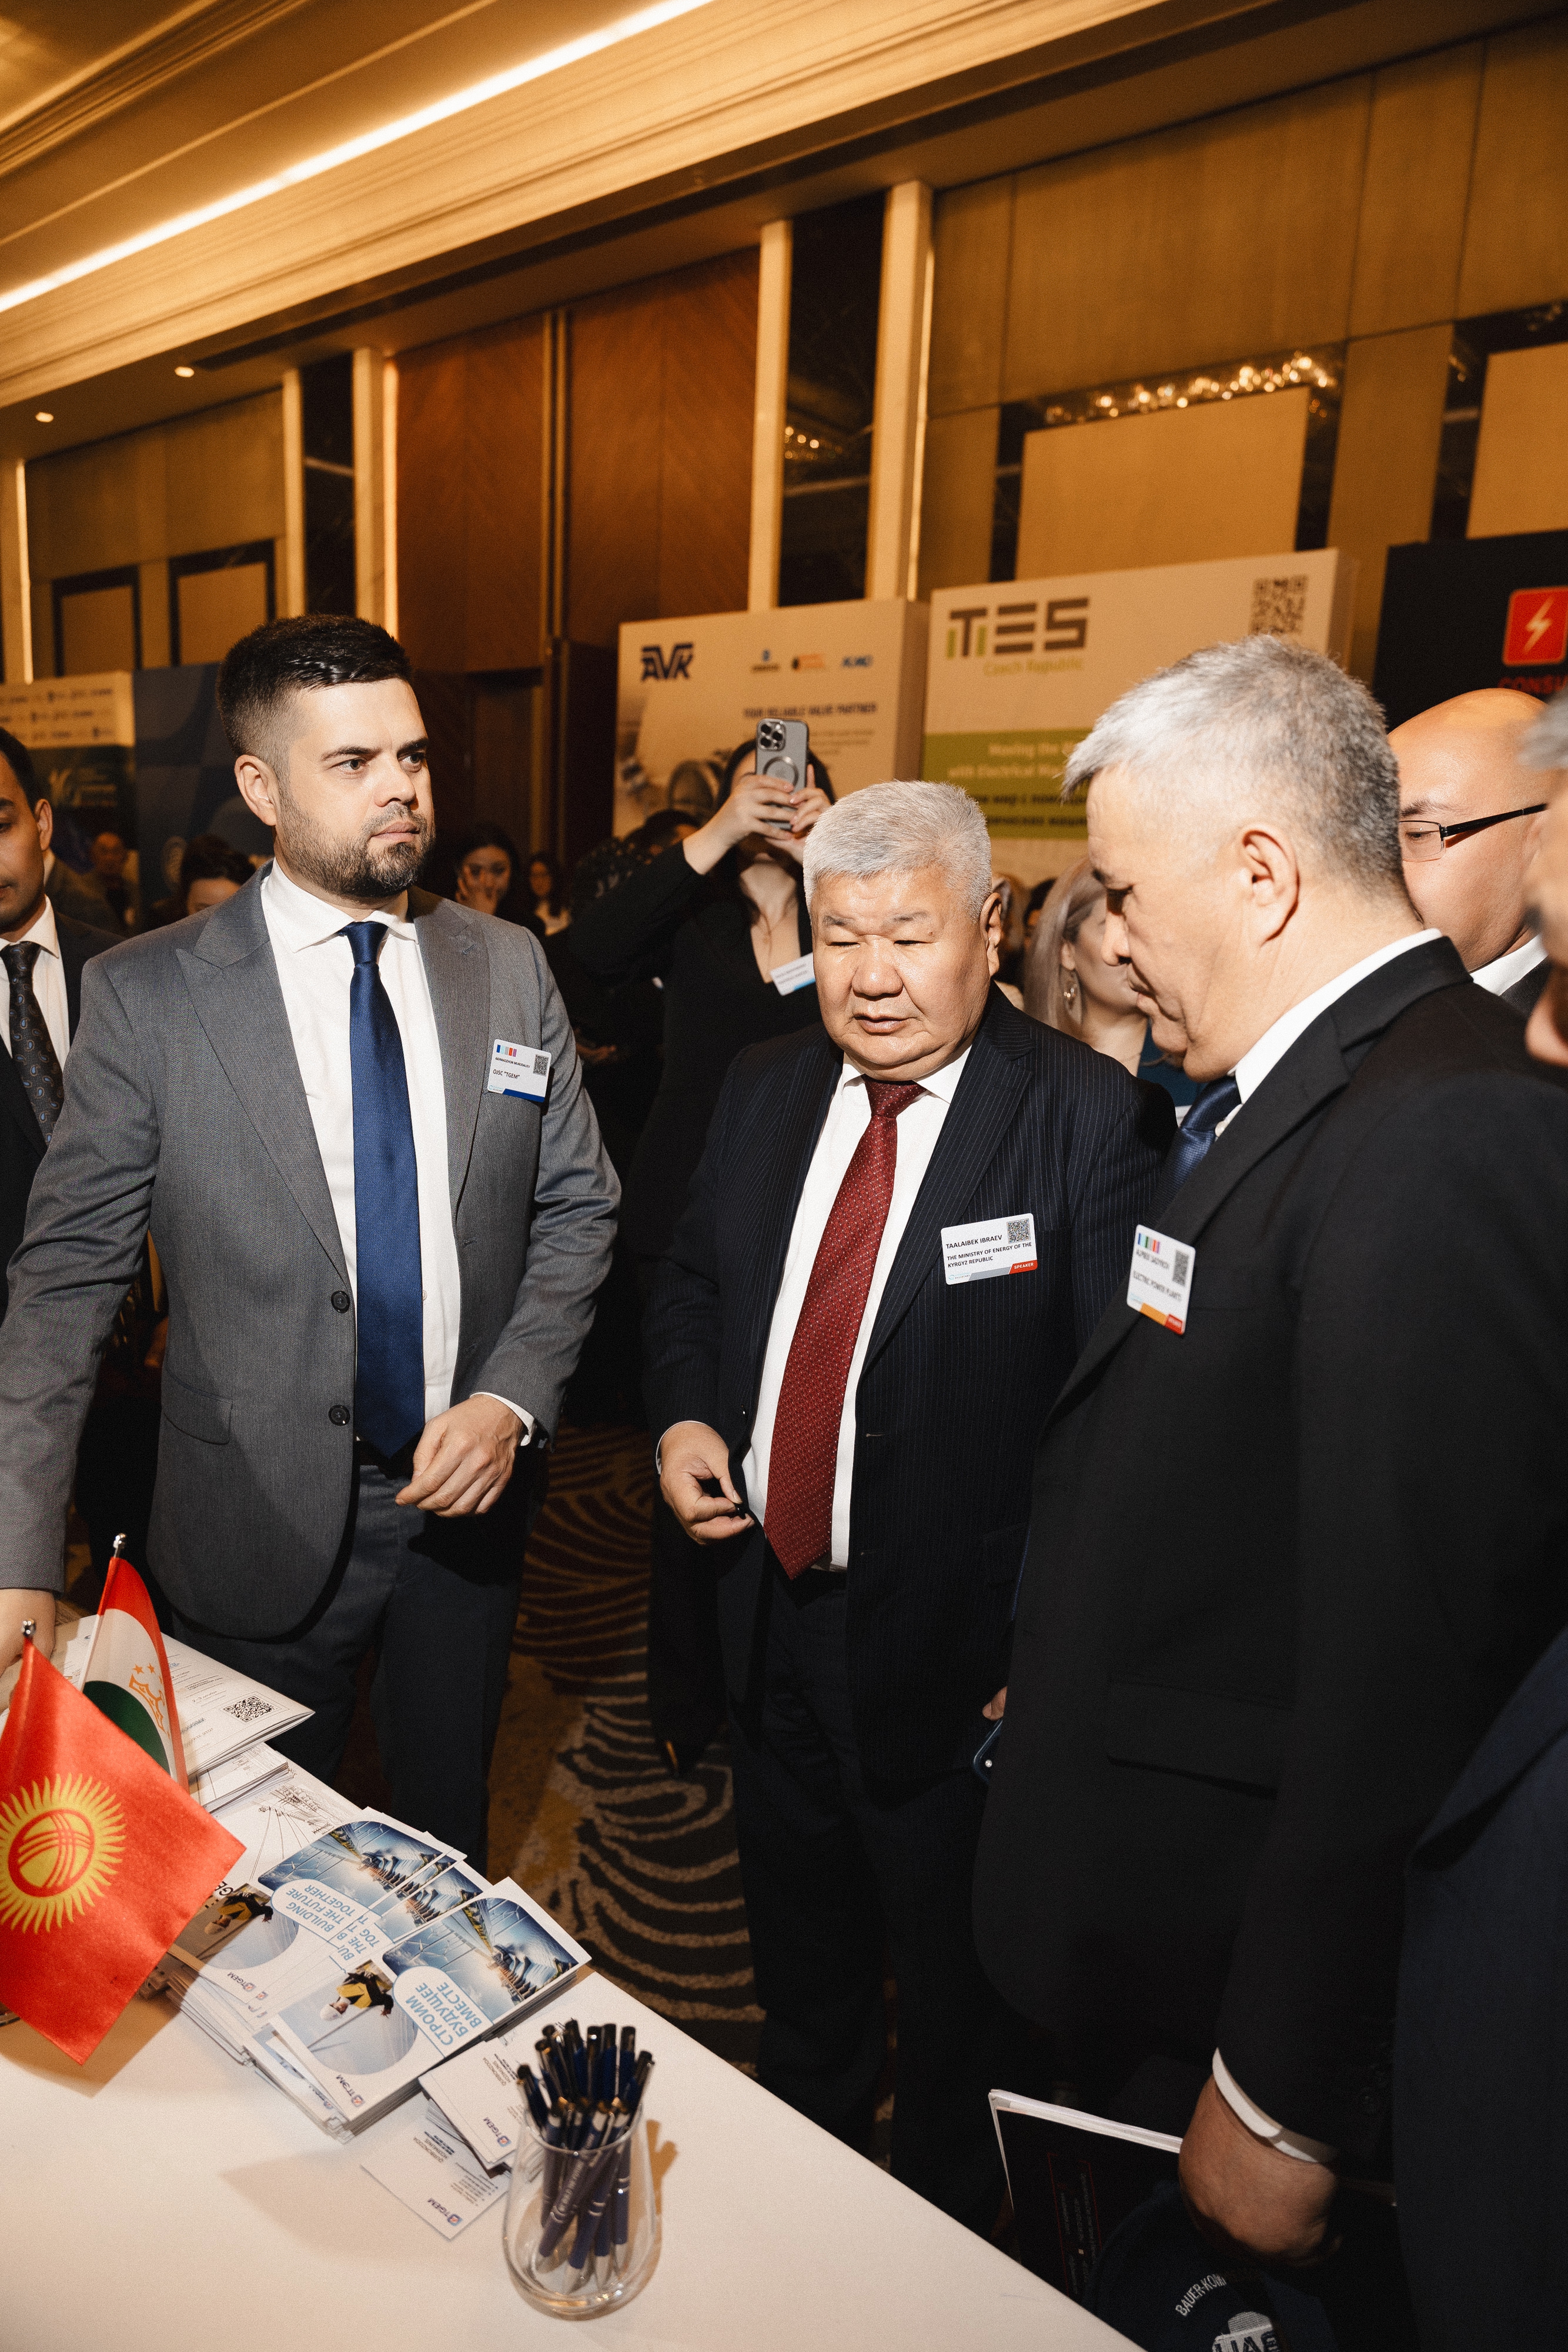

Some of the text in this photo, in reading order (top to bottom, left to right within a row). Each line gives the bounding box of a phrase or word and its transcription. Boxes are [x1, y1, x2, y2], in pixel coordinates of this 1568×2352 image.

[946, 1235, 1002, 1249] TAALAIBEK IBRAEV
[948, 1256, 994, 1268] KYRGYZ REPUBLIC
[958, 1251, 983, 1259] MINISTRY
[286, 1888, 326, 1912] FUTURE
[304, 1885, 356, 1917] TOGETHER
[286, 1902, 335, 1933] BUILDING
[323, 1909, 345, 1925] THE
[415, 1983, 469, 2037] БУДУЩЕЕ
[436, 1982, 482, 2028] ВМЕСТЕ
[406, 1995, 454, 2045] СТРОИМ
[483, 2117, 503, 2137] TGEM
[427, 2197, 450, 2217] TGEM
